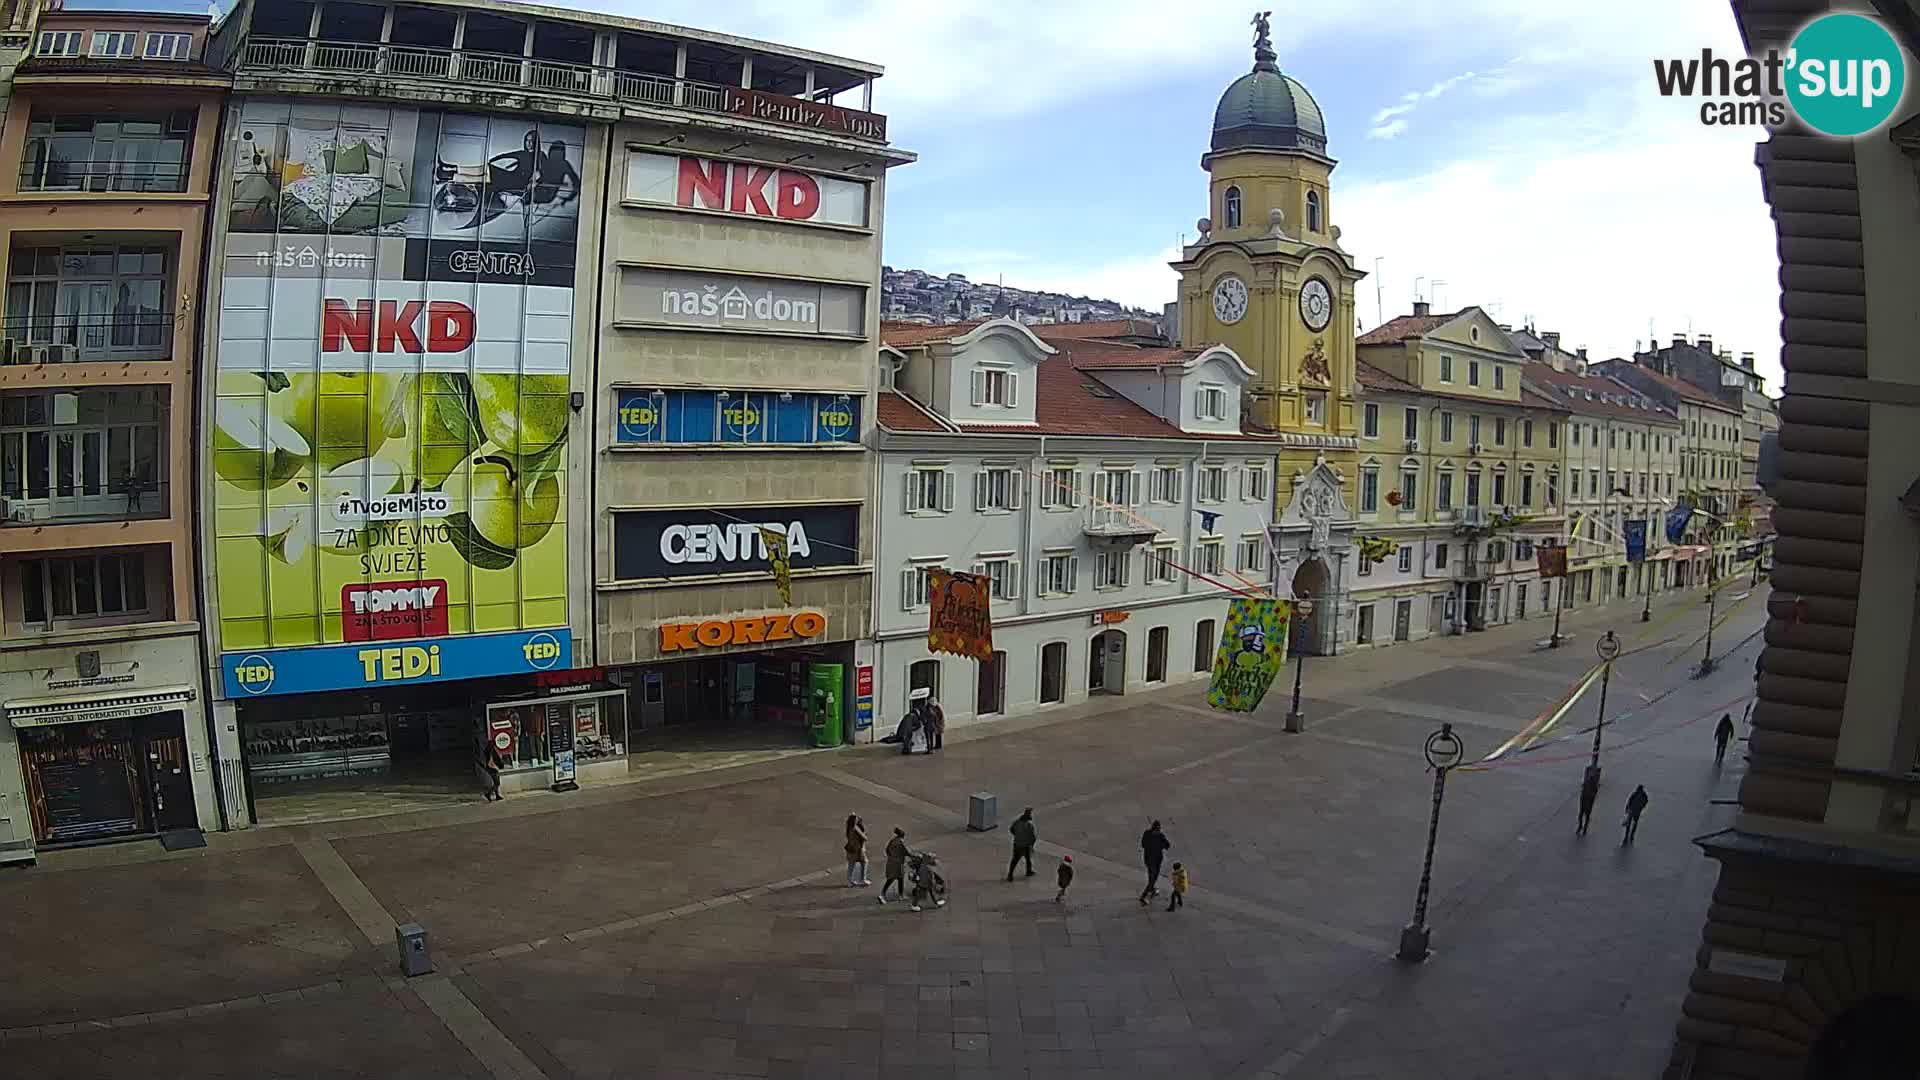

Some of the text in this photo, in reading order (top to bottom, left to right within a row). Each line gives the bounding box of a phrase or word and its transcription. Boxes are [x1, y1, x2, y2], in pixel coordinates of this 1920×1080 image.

[723, 89, 746, 112] Le
[676, 157, 820, 220] NKD
[256, 246, 367, 270] naš dom
[448, 249, 537, 277] CENTRA
[662, 284, 817, 323] naš dom
[322, 297, 477, 354] NKD
[339, 496, 448, 517] #TvojeMisto
[335, 523, 452, 549] ZA DNEVNO
[360, 548, 428, 575] SVJEŽE
[350, 586, 441, 615] TOMMY
[659, 612, 825, 652] KORZO
